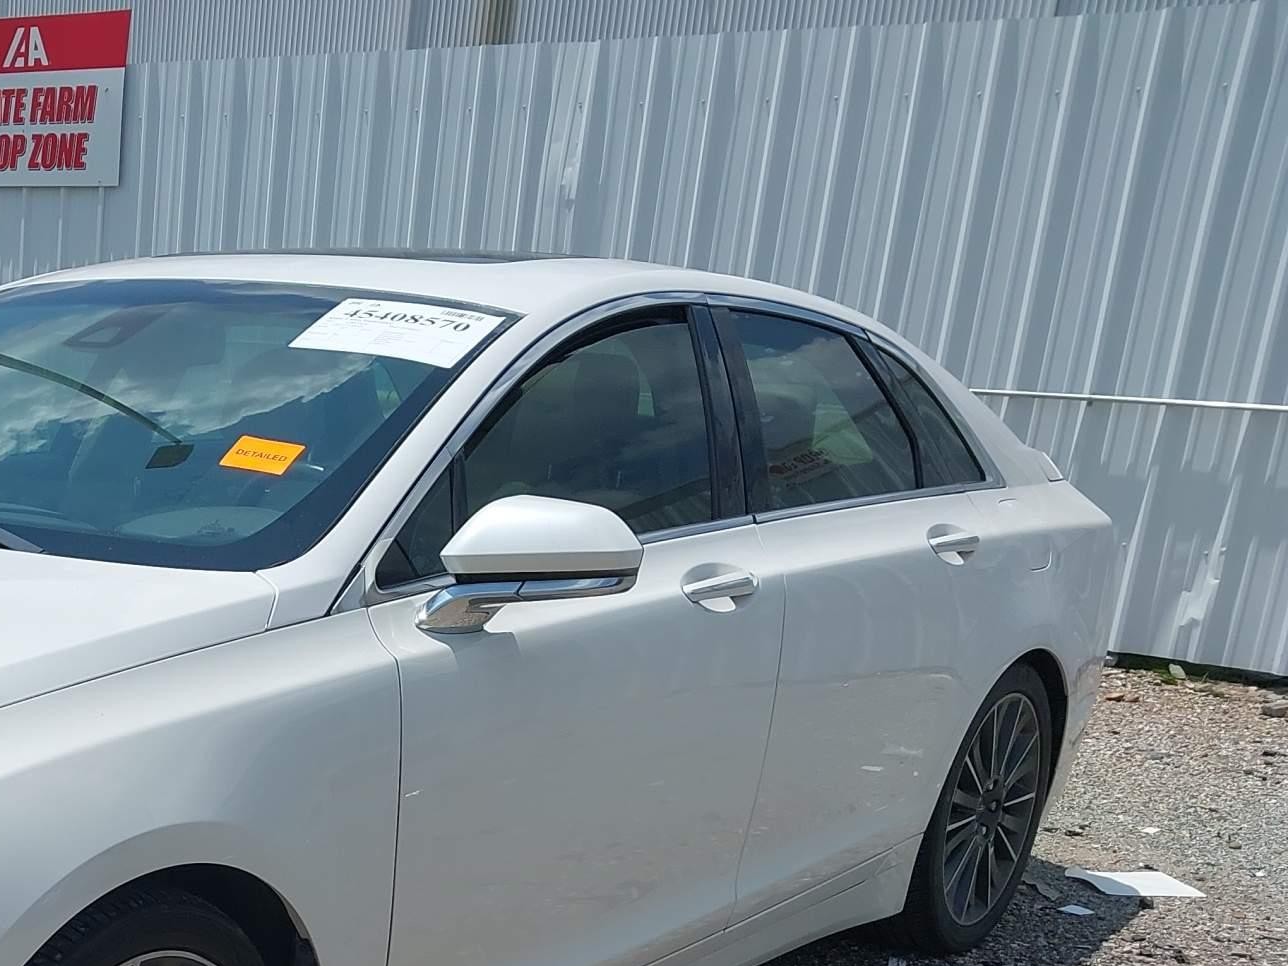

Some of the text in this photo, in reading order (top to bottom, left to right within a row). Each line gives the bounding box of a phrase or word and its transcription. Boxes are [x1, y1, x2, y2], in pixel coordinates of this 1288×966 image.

[29, 85, 98, 125] FARM
[27, 132, 89, 170] ZONE
[344, 309, 471, 331] 45408570
[235, 448, 288, 462] DETAILED
